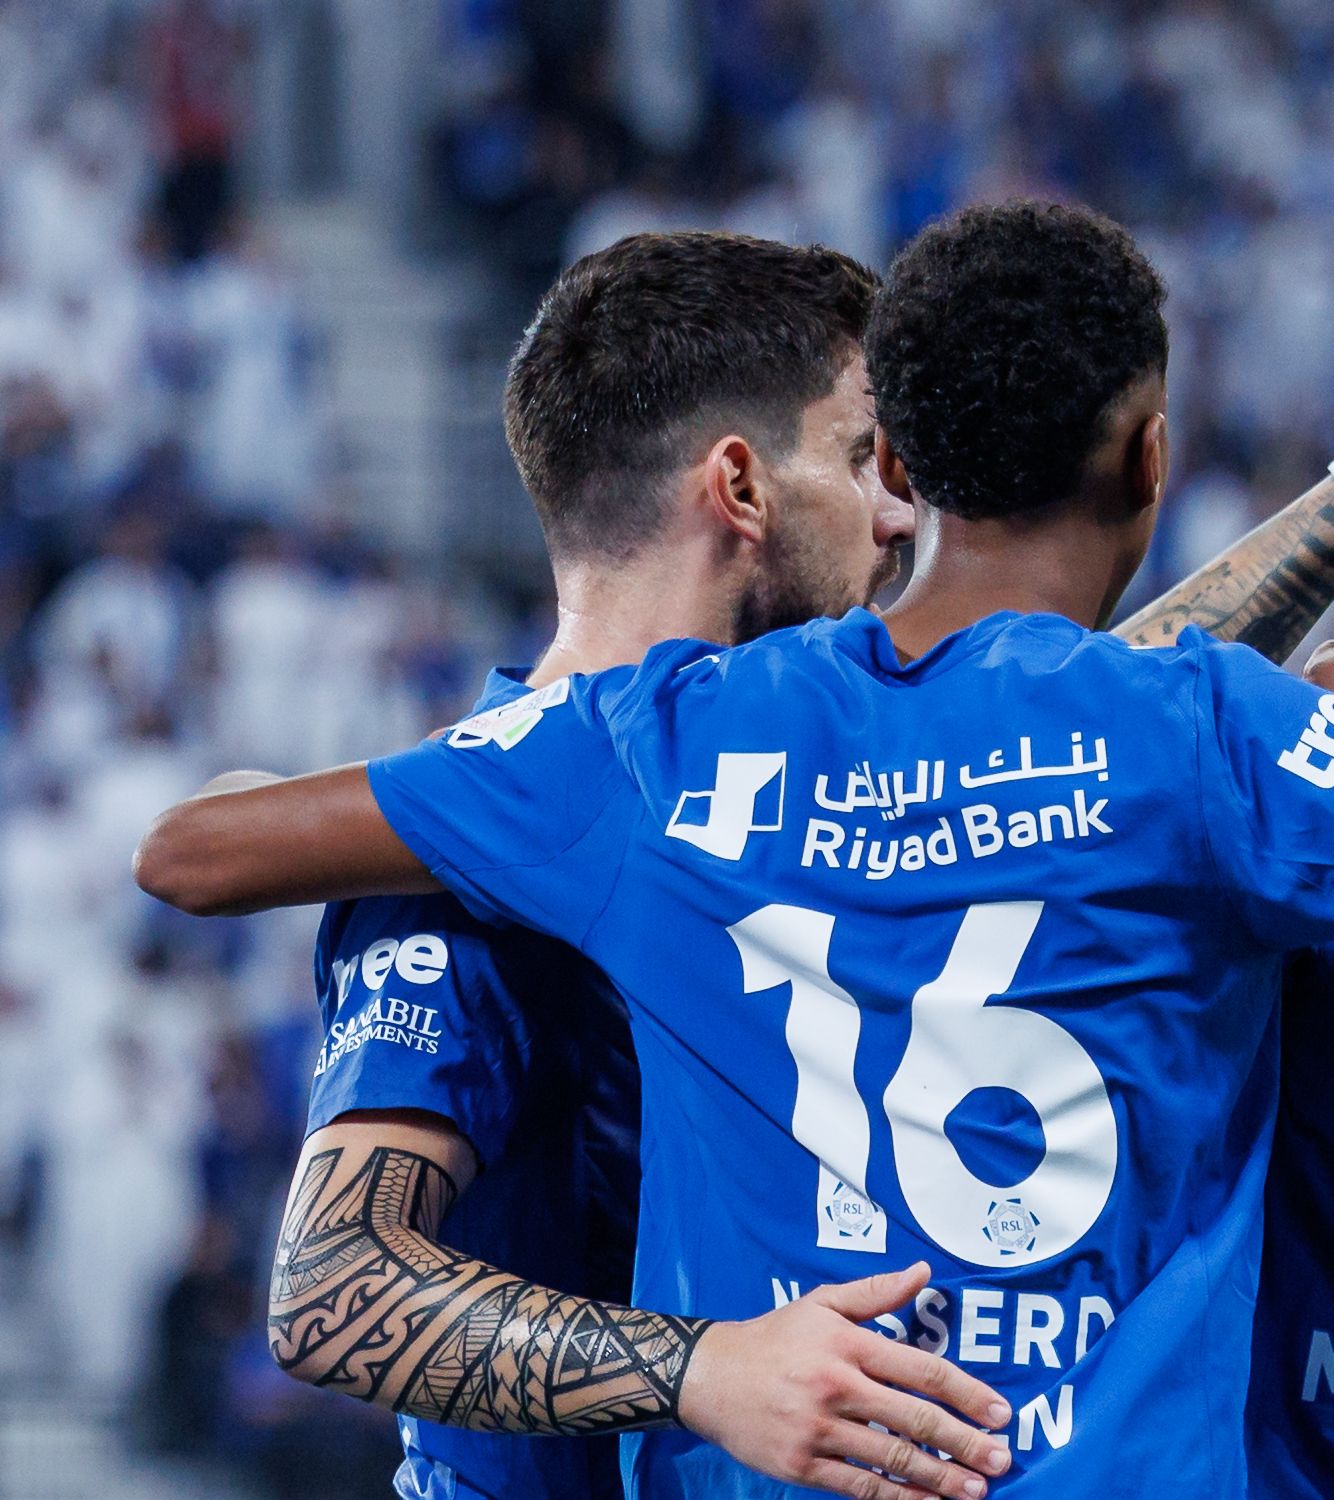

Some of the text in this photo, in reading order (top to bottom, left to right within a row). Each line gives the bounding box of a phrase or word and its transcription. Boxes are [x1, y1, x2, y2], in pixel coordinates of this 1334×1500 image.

[801, 789, 1114, 880] Riyad Bank
[725, 900, 1118, 1268] 16
[843, 1202, 862, 1215] RSL
[1001, 1220, 1023, 1232] RSL
